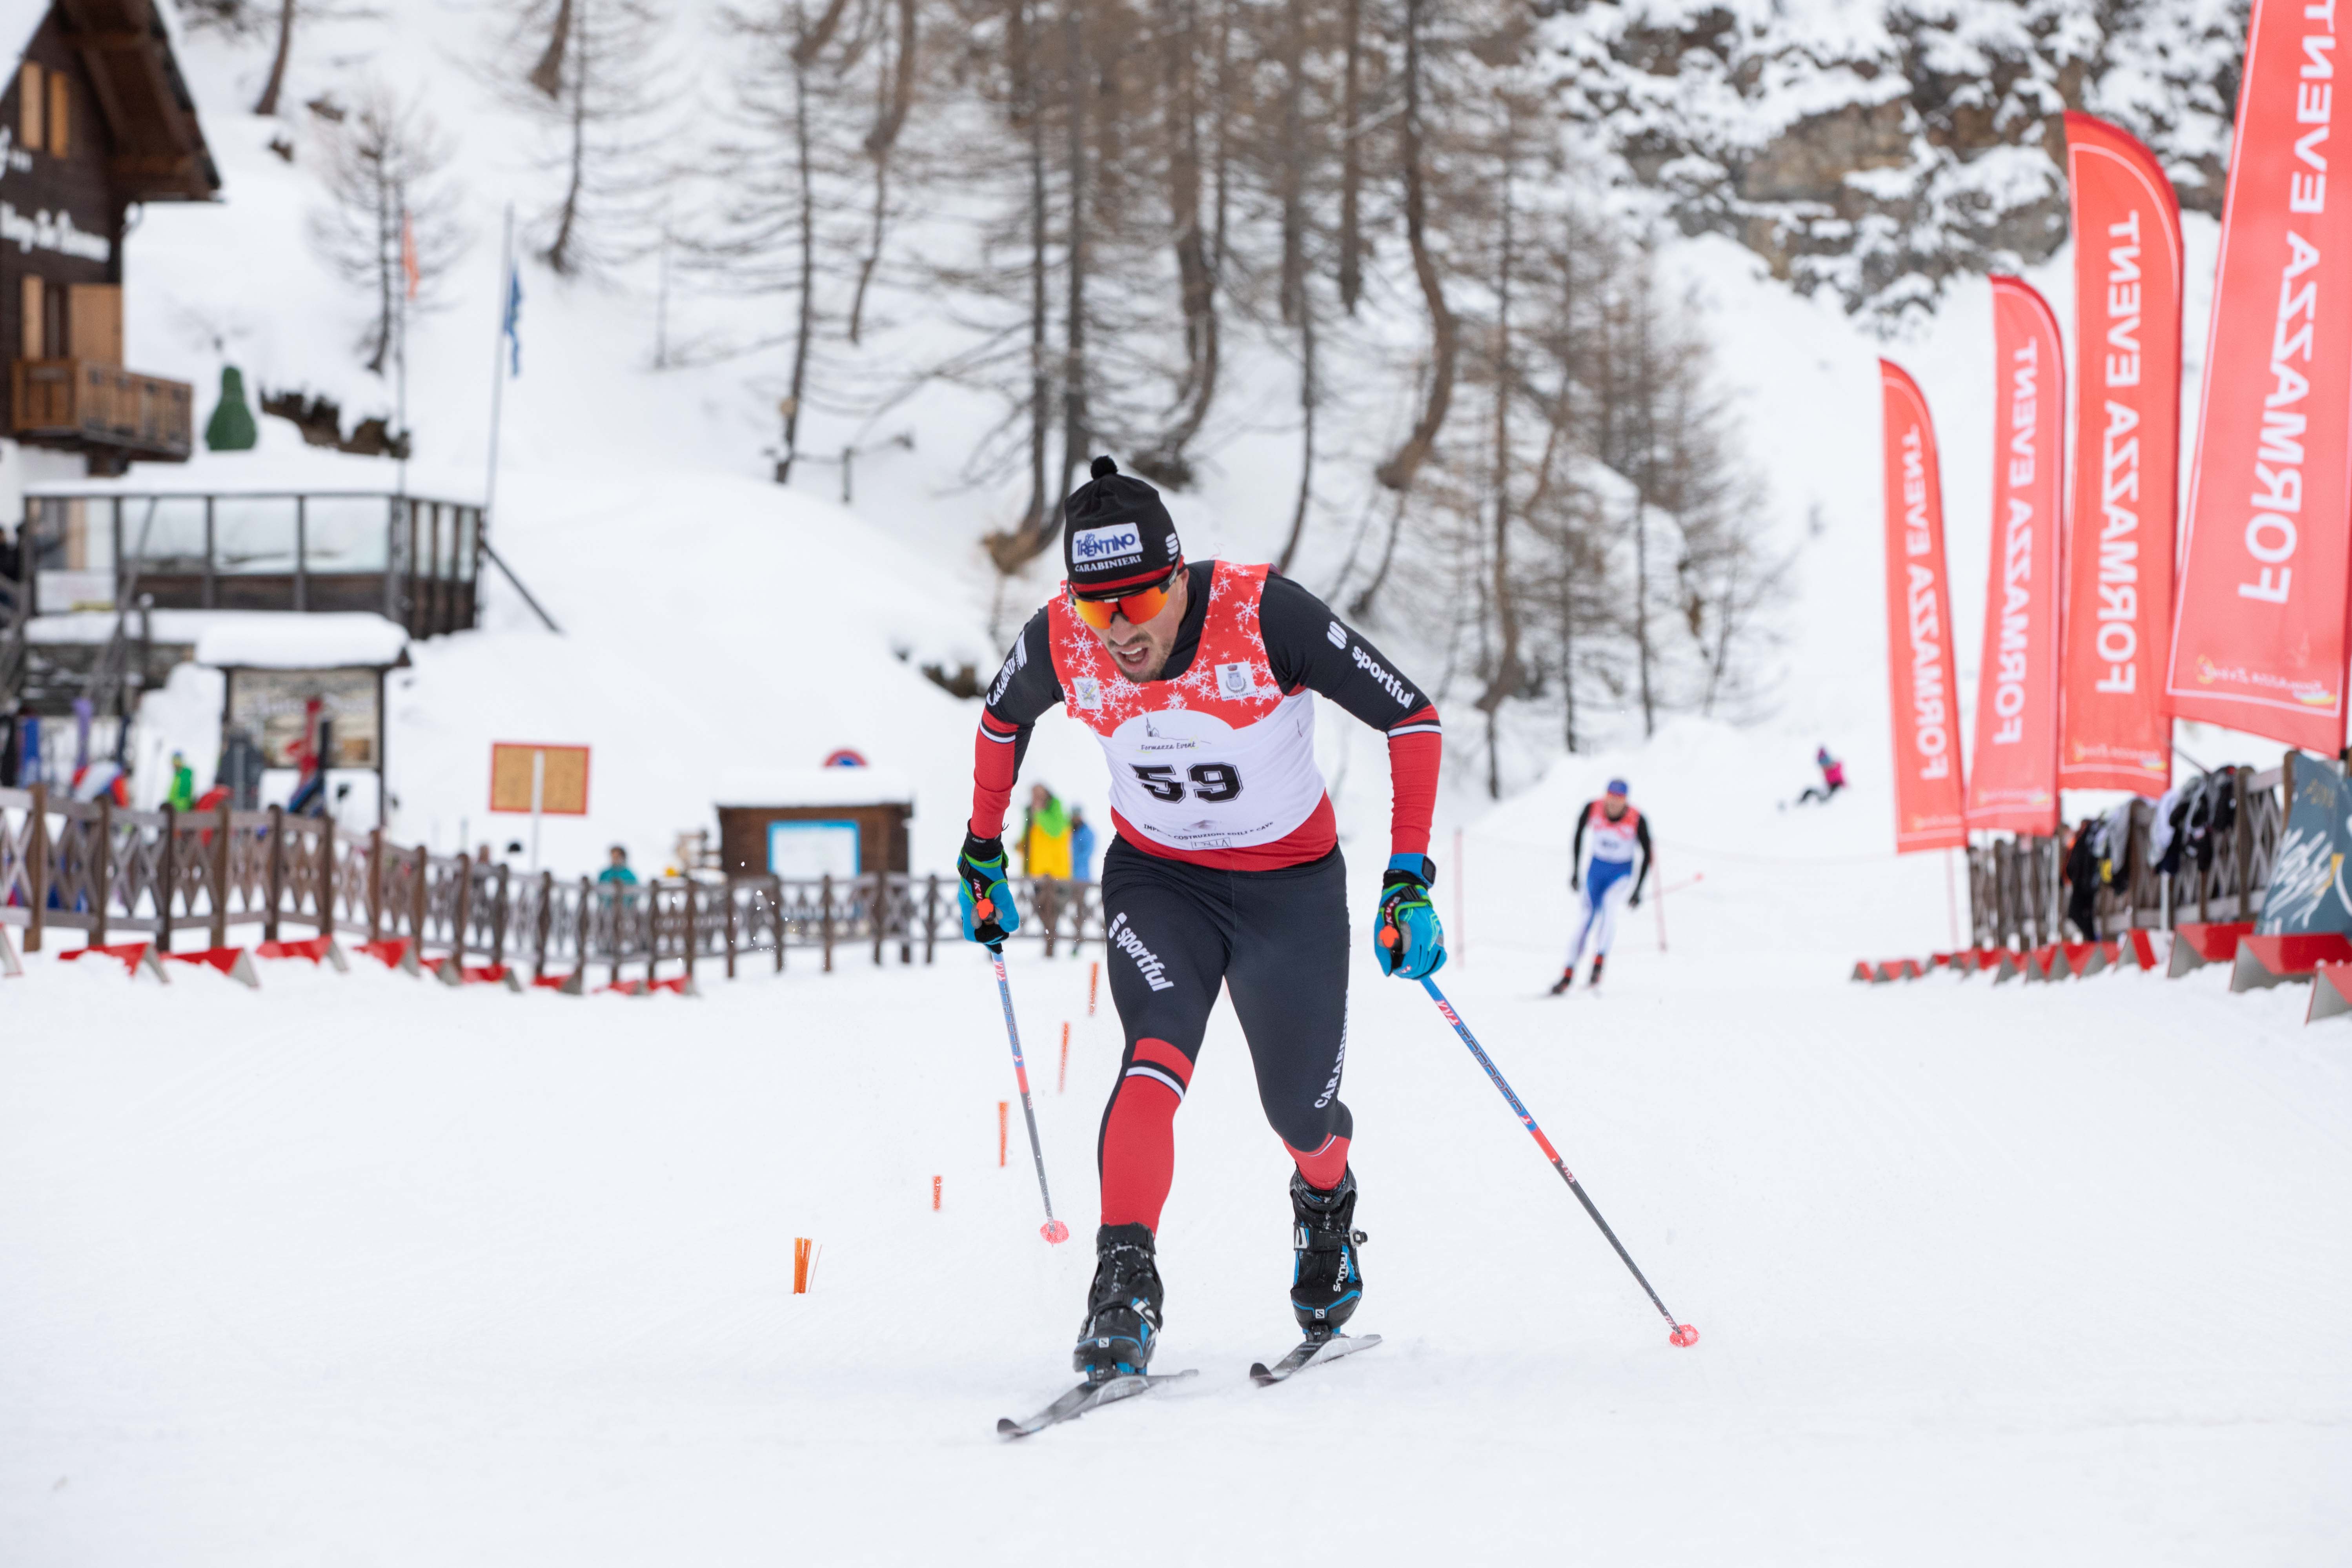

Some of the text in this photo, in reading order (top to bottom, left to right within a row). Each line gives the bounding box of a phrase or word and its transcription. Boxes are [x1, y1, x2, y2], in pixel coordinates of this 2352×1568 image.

[1076, 533, 1136, 557] TRENTINO
[1074, 555, 1142, 572] CARABINIERI
[1352, 646, 1415, 709] sportful
[1128, 762, 1243, 804] 59
[1174, 830, 1225, 840] COSTRUZIONI
[1116, 927, 1174, 992] sportful
